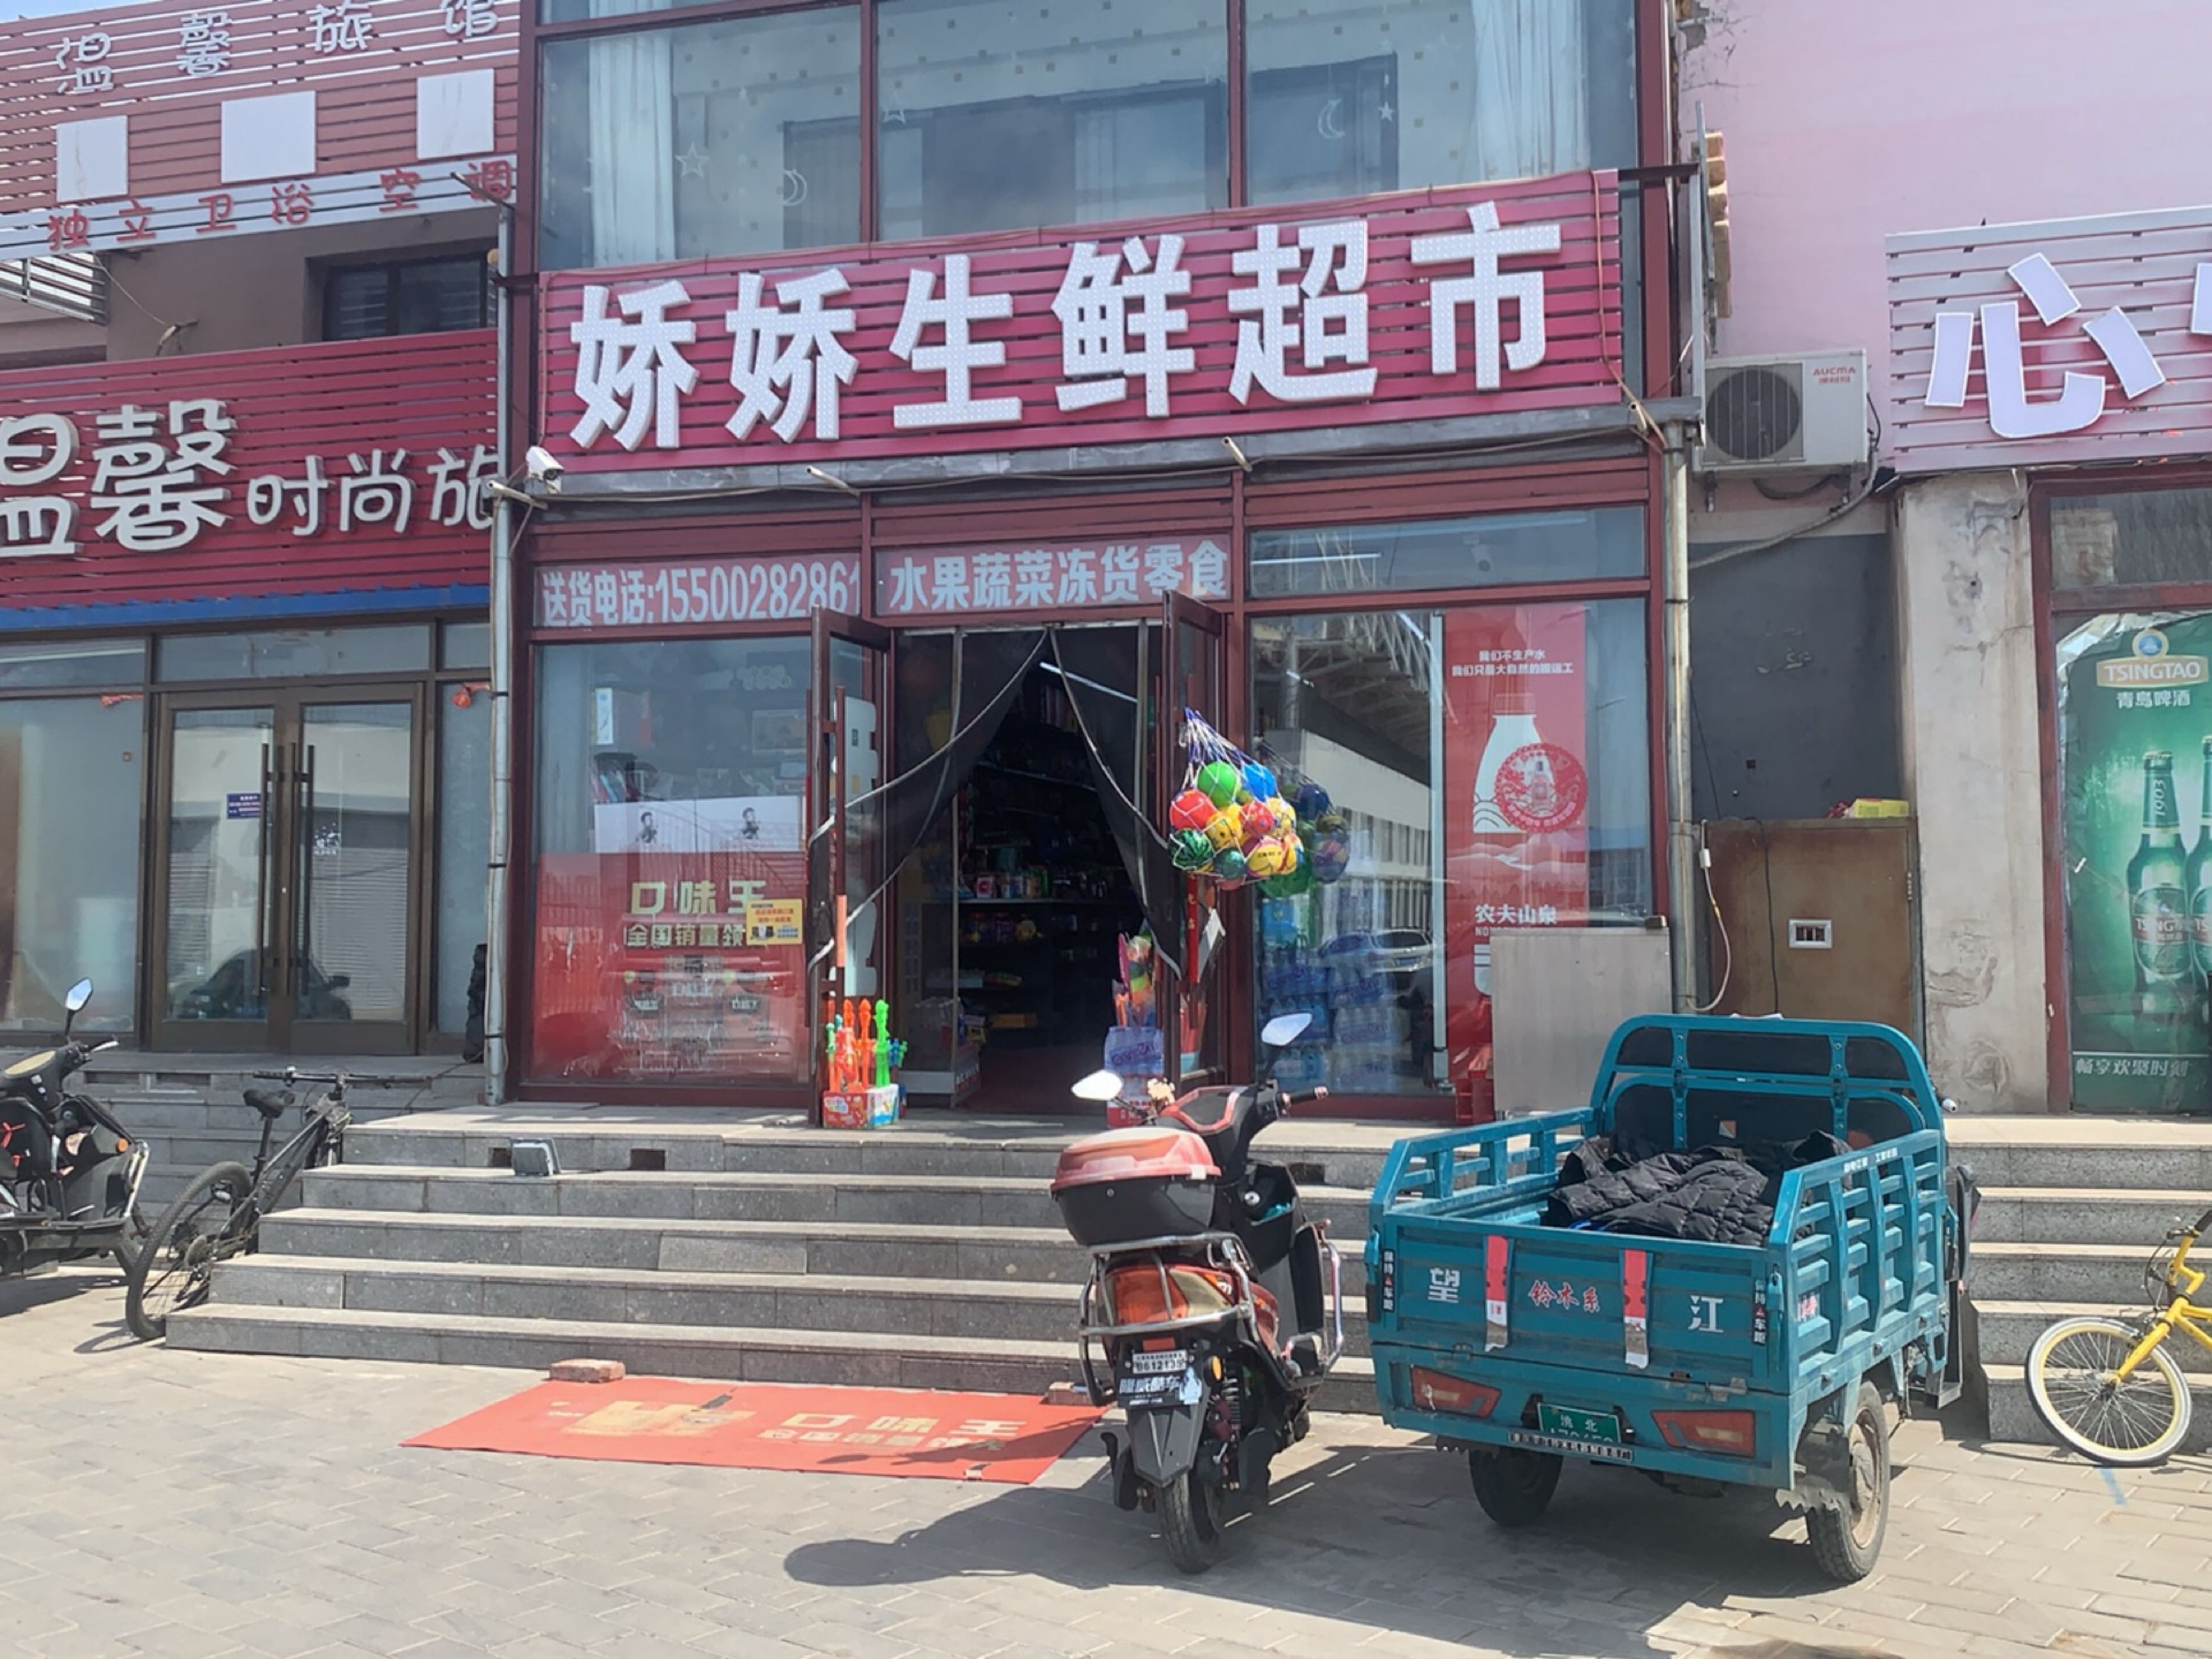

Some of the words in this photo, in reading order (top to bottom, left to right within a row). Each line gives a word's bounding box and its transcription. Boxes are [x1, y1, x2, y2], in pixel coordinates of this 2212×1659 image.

[47, 161, 511, 250] 独立卫浴空调
[570, 201, 1562, 451] 娇娇生鲜超市
[1925, 252, 2212, 439] 心
[890, 540, 1228, 613] 水果蔬菜冻货零食
[1479, 648, 1546, 662] 我们不生产水
[2104, 661, 2201, 682] TSINGTAO
[2116, 689, 2191, 709] 青岛啤酒
[2152, 778, 2167, 817] 1903
[631, 879, 767, 915] 口味王
[1475, 903, 1557, 926] 农夫山泉
[1427, 1266, 1461, 1304] 望
[1528, 1279, 1601, 1313] 铃木系
[1688, 1294, 1724, 1333] 江
[779, 1412, 1028, 1438] 口味王
